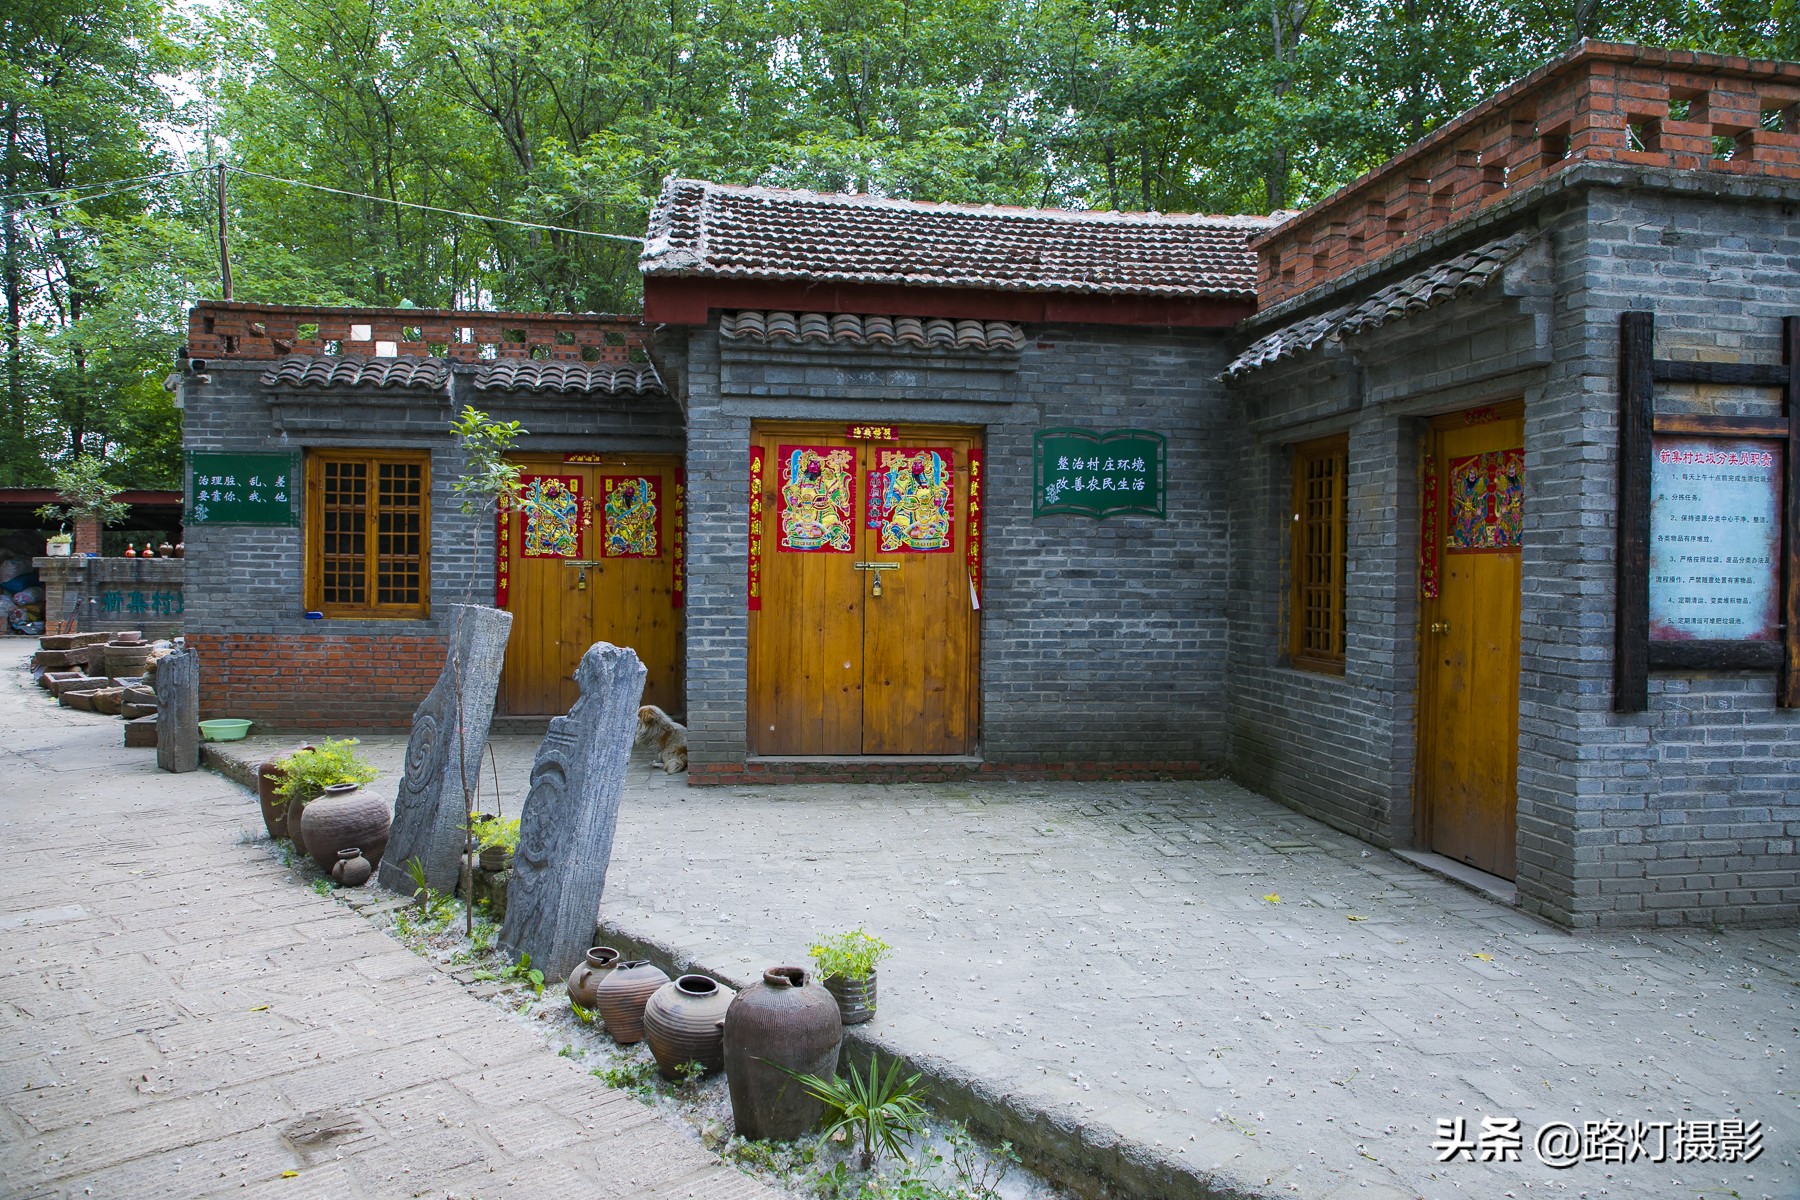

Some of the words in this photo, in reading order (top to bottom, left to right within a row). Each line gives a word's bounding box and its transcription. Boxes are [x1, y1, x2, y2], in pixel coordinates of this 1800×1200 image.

[1056, 456, 1146, 473] 整治村庄环境
[1659, 449, 1773, 467] 新集村垃圾分类员职责
[198, 475, 285, 488] 治理脏、乱、差
[1056, 476, 1146, 492] 改善农民生活
[197, 490, 288, 503] 要靠你、我、他
